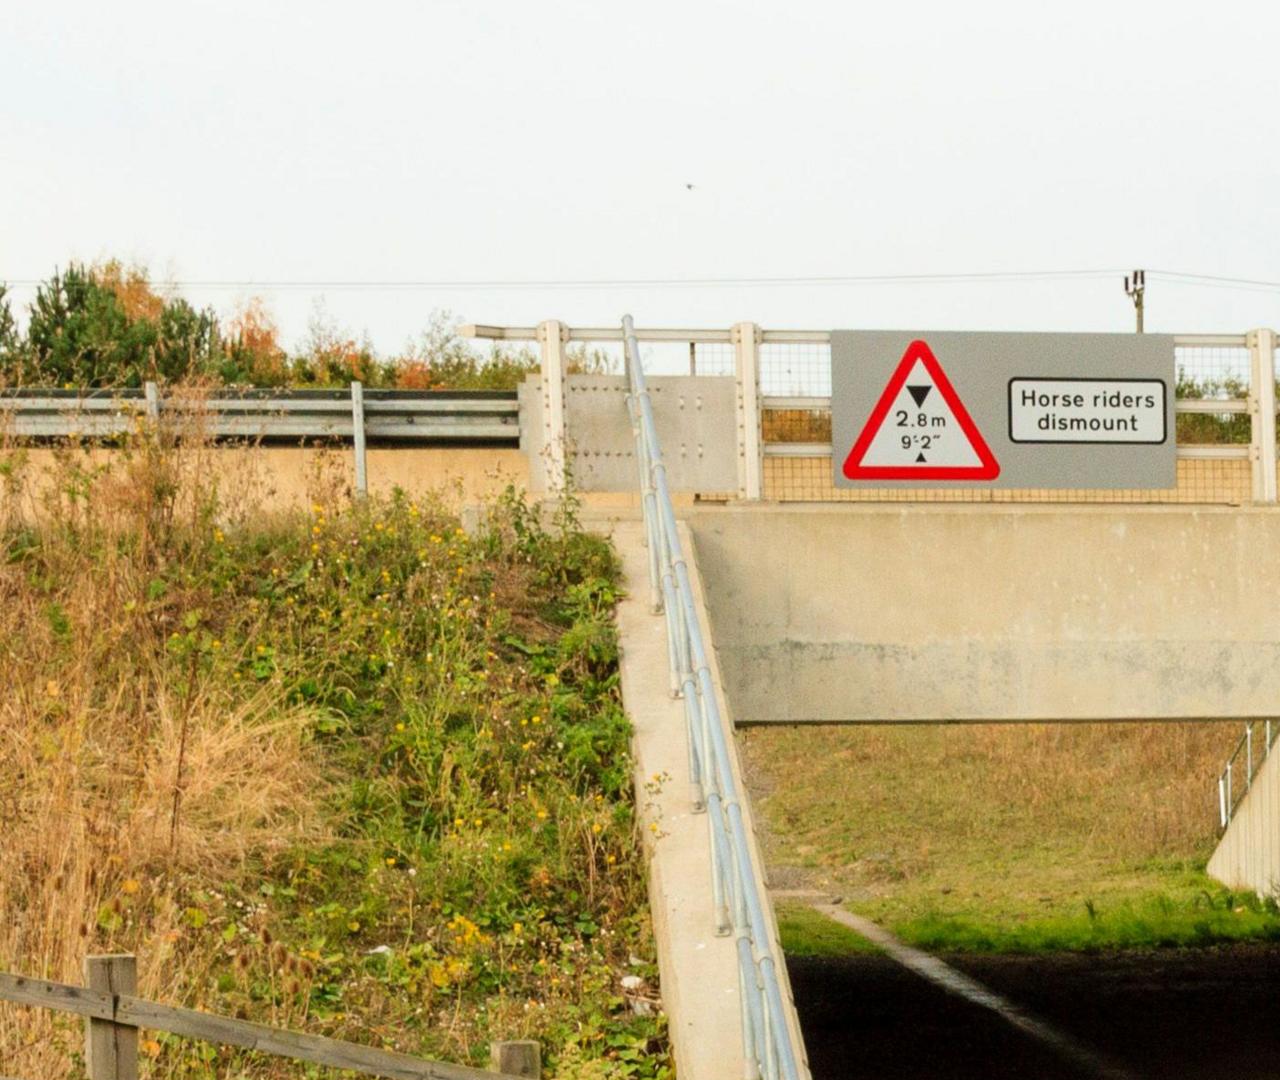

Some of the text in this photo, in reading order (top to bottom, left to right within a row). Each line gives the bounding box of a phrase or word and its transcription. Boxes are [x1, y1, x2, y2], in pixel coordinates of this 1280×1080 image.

[1021, 389, 1155, 409] Horse riders
[1037, 413, 1138, 432] dismount
